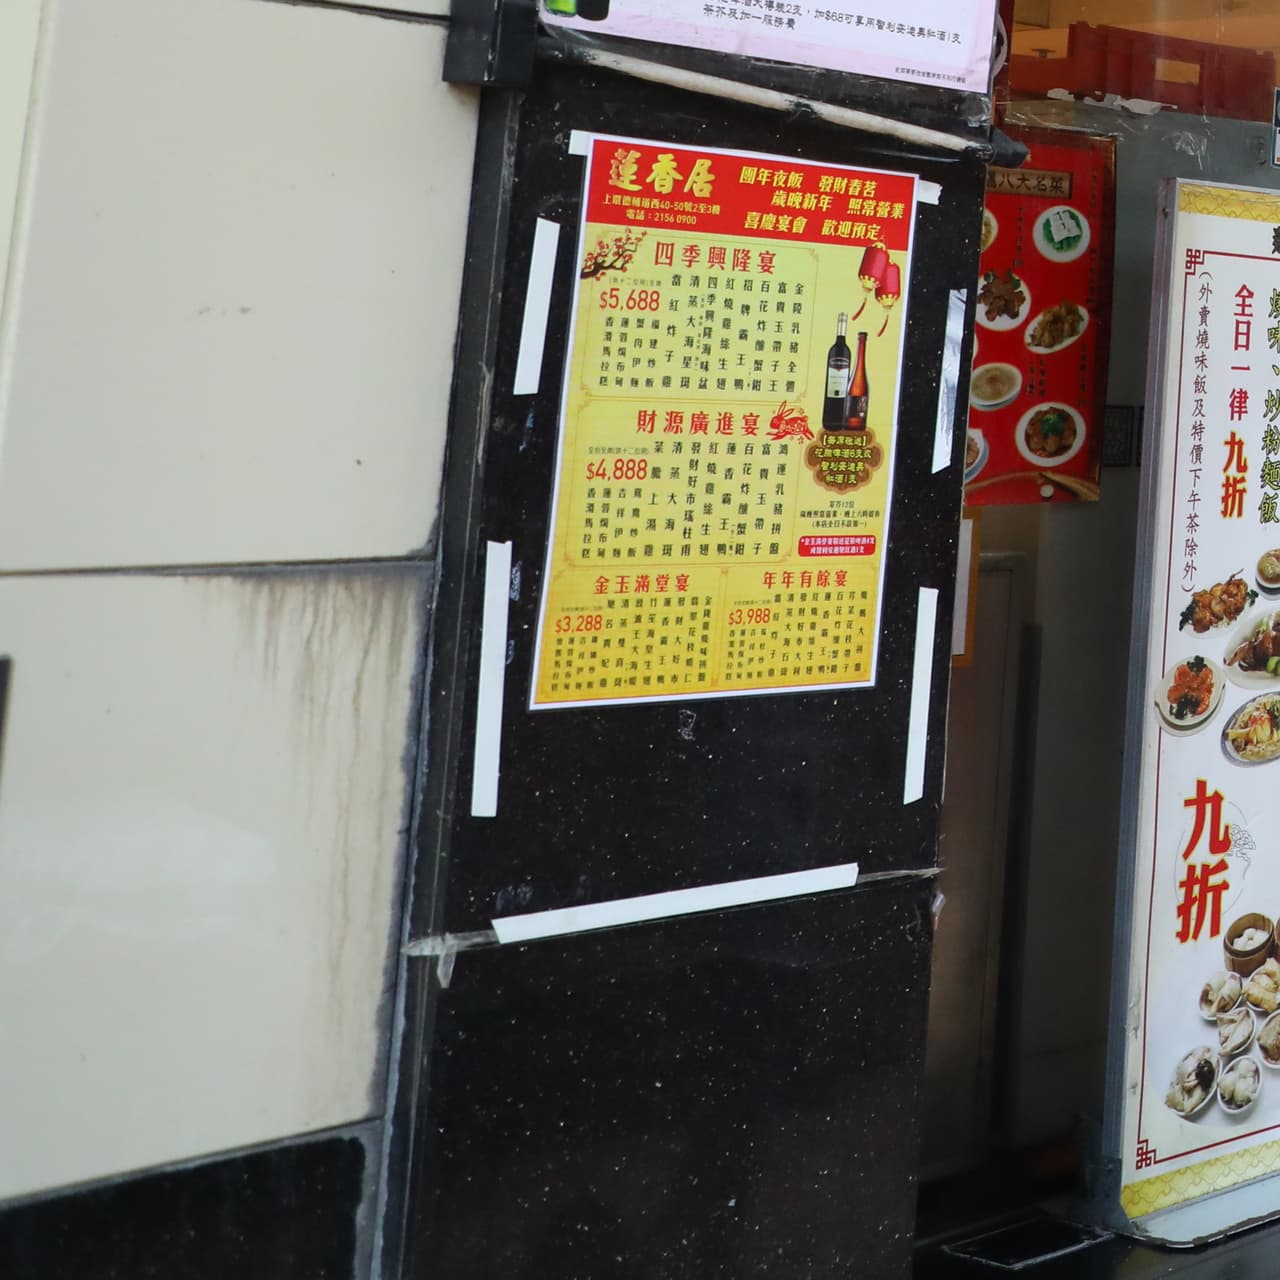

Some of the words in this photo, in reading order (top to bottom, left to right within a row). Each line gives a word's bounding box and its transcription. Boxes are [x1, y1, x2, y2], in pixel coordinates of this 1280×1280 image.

[608, 148, 717, 198] 蓮香居
[739, 166, 804, 190] 團年夜飯
[818, 174, 878, 198] 發財春茗
[654, 211, 674, 224] 2156
[675, 213, 697, 226] 0900
[771, 190, 833, 213] 歲晚新年
[847, 197, 905, 220] 照常營業
[743, 211, 808, 235] 喜慶宴會
[821, 218, 882, 242] 歡迎預定
[654, 241, 778, 276] 四季興隆宴
[599, 288, 660, 313] $5,688
[636, 410, 761, 437] 財源廣進宴
[585, 458, 648, 481] $4,888
[1220, 431, 1250, 520] 九折
[593, 574, 690, 595] 金玉滿堂宴
[762, 570, 849, 590] 年年有餘宴
[555, 615, 603, 634] $3,288
[728, 608, 771, 626] $3,988
[1176, 778, 1231, 944] 九折
